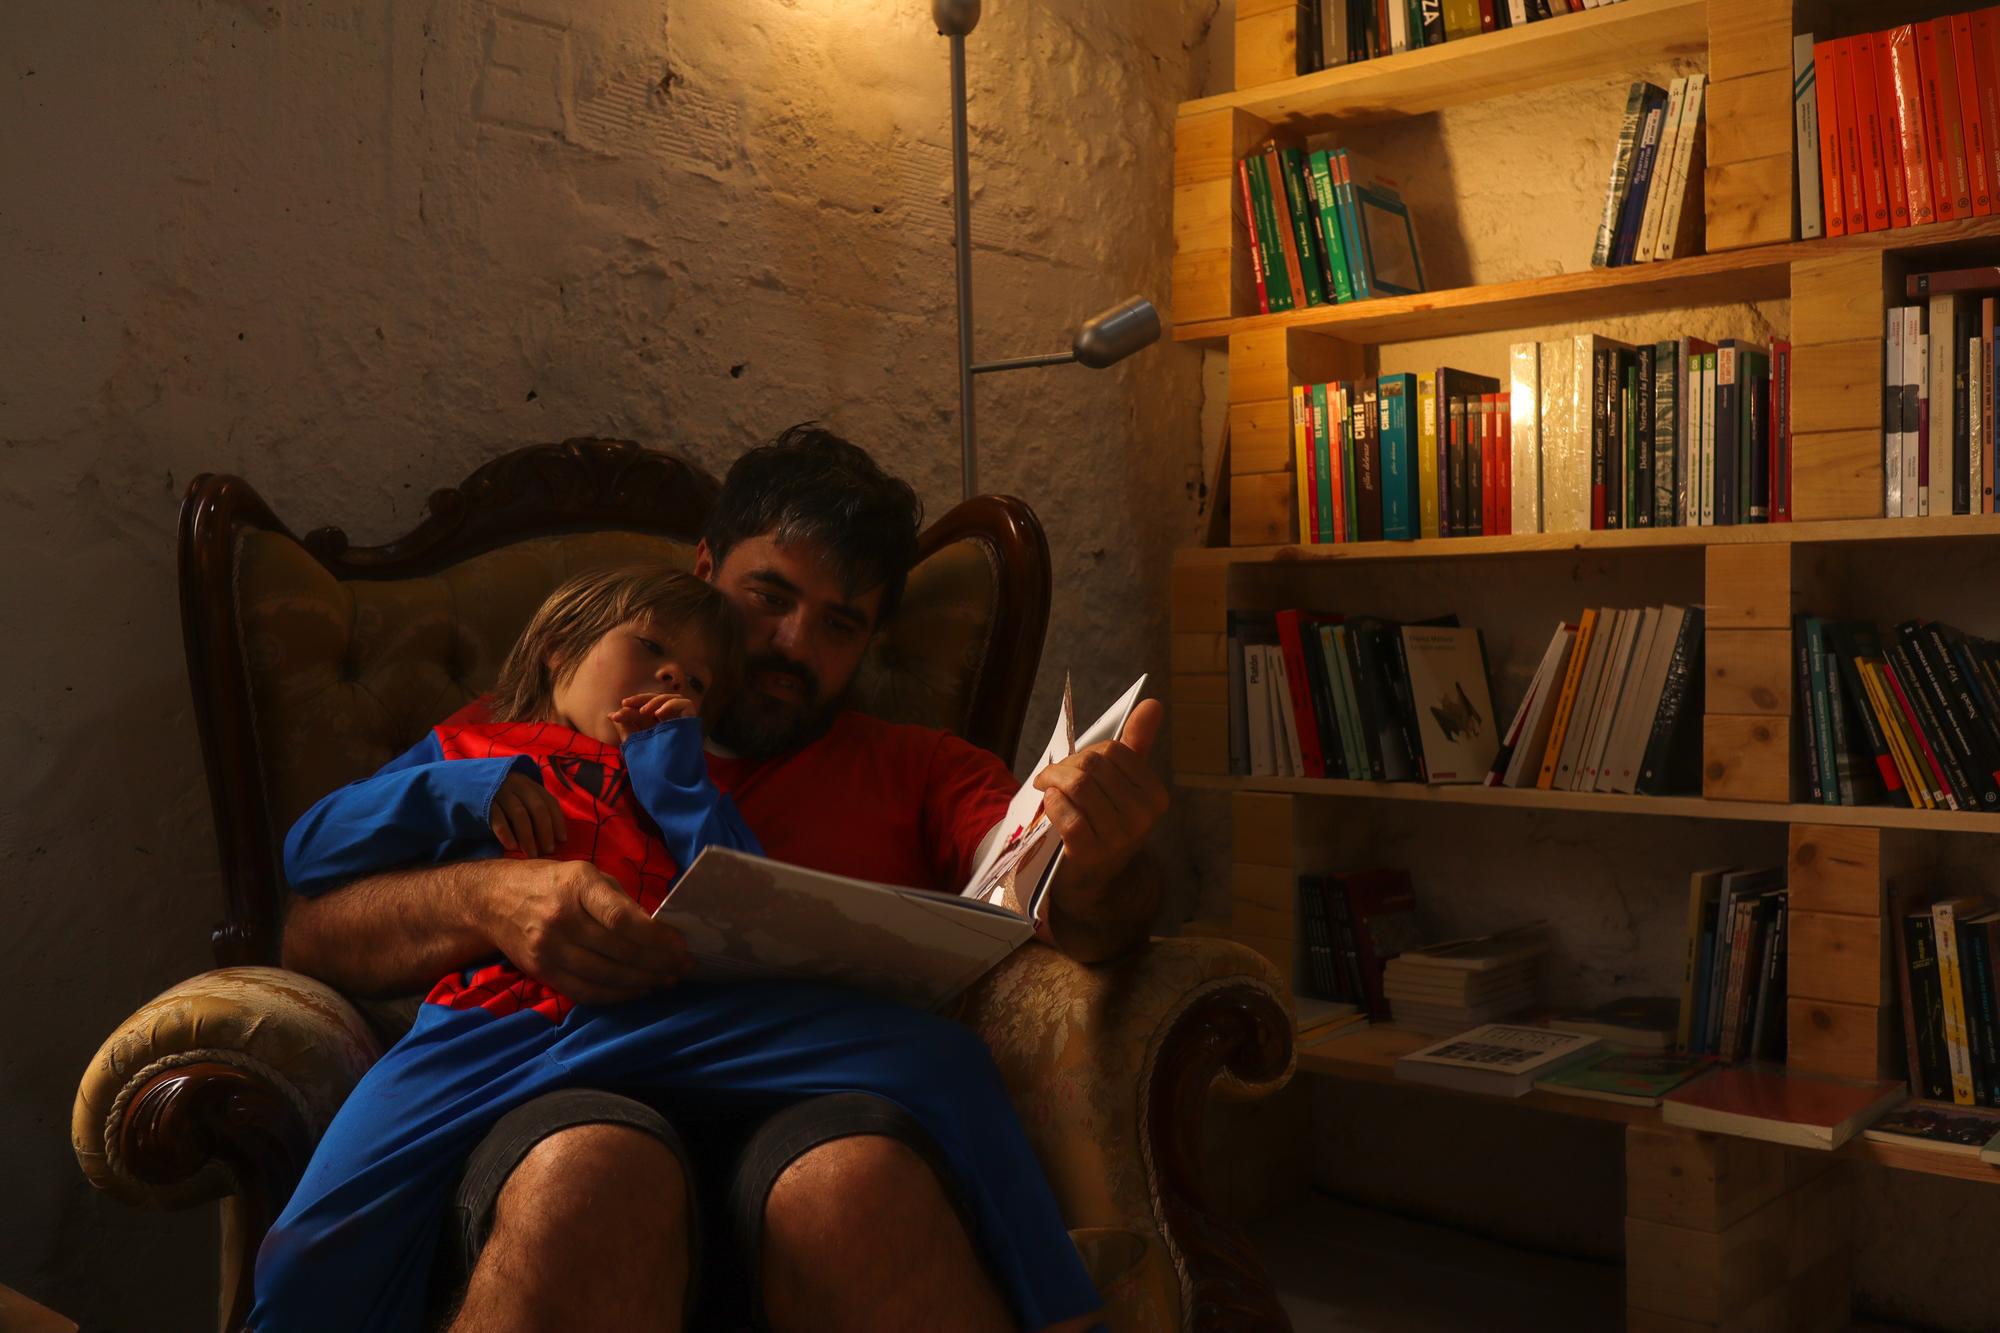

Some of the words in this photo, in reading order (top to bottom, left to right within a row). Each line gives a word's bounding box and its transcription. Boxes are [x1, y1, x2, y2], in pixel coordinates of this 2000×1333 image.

[1639, 352, 1648, 381] filosofía
[1353, 404, 1364, 413] II
[1380, 399, 1389, 409] III
[1424, 398, 1435, 436] SPINOZA
[1354, 414, 1366, 440] CINE
[1380, 410, 1389, 430] CINE
[1250, 655, 1258, 684] Platón
